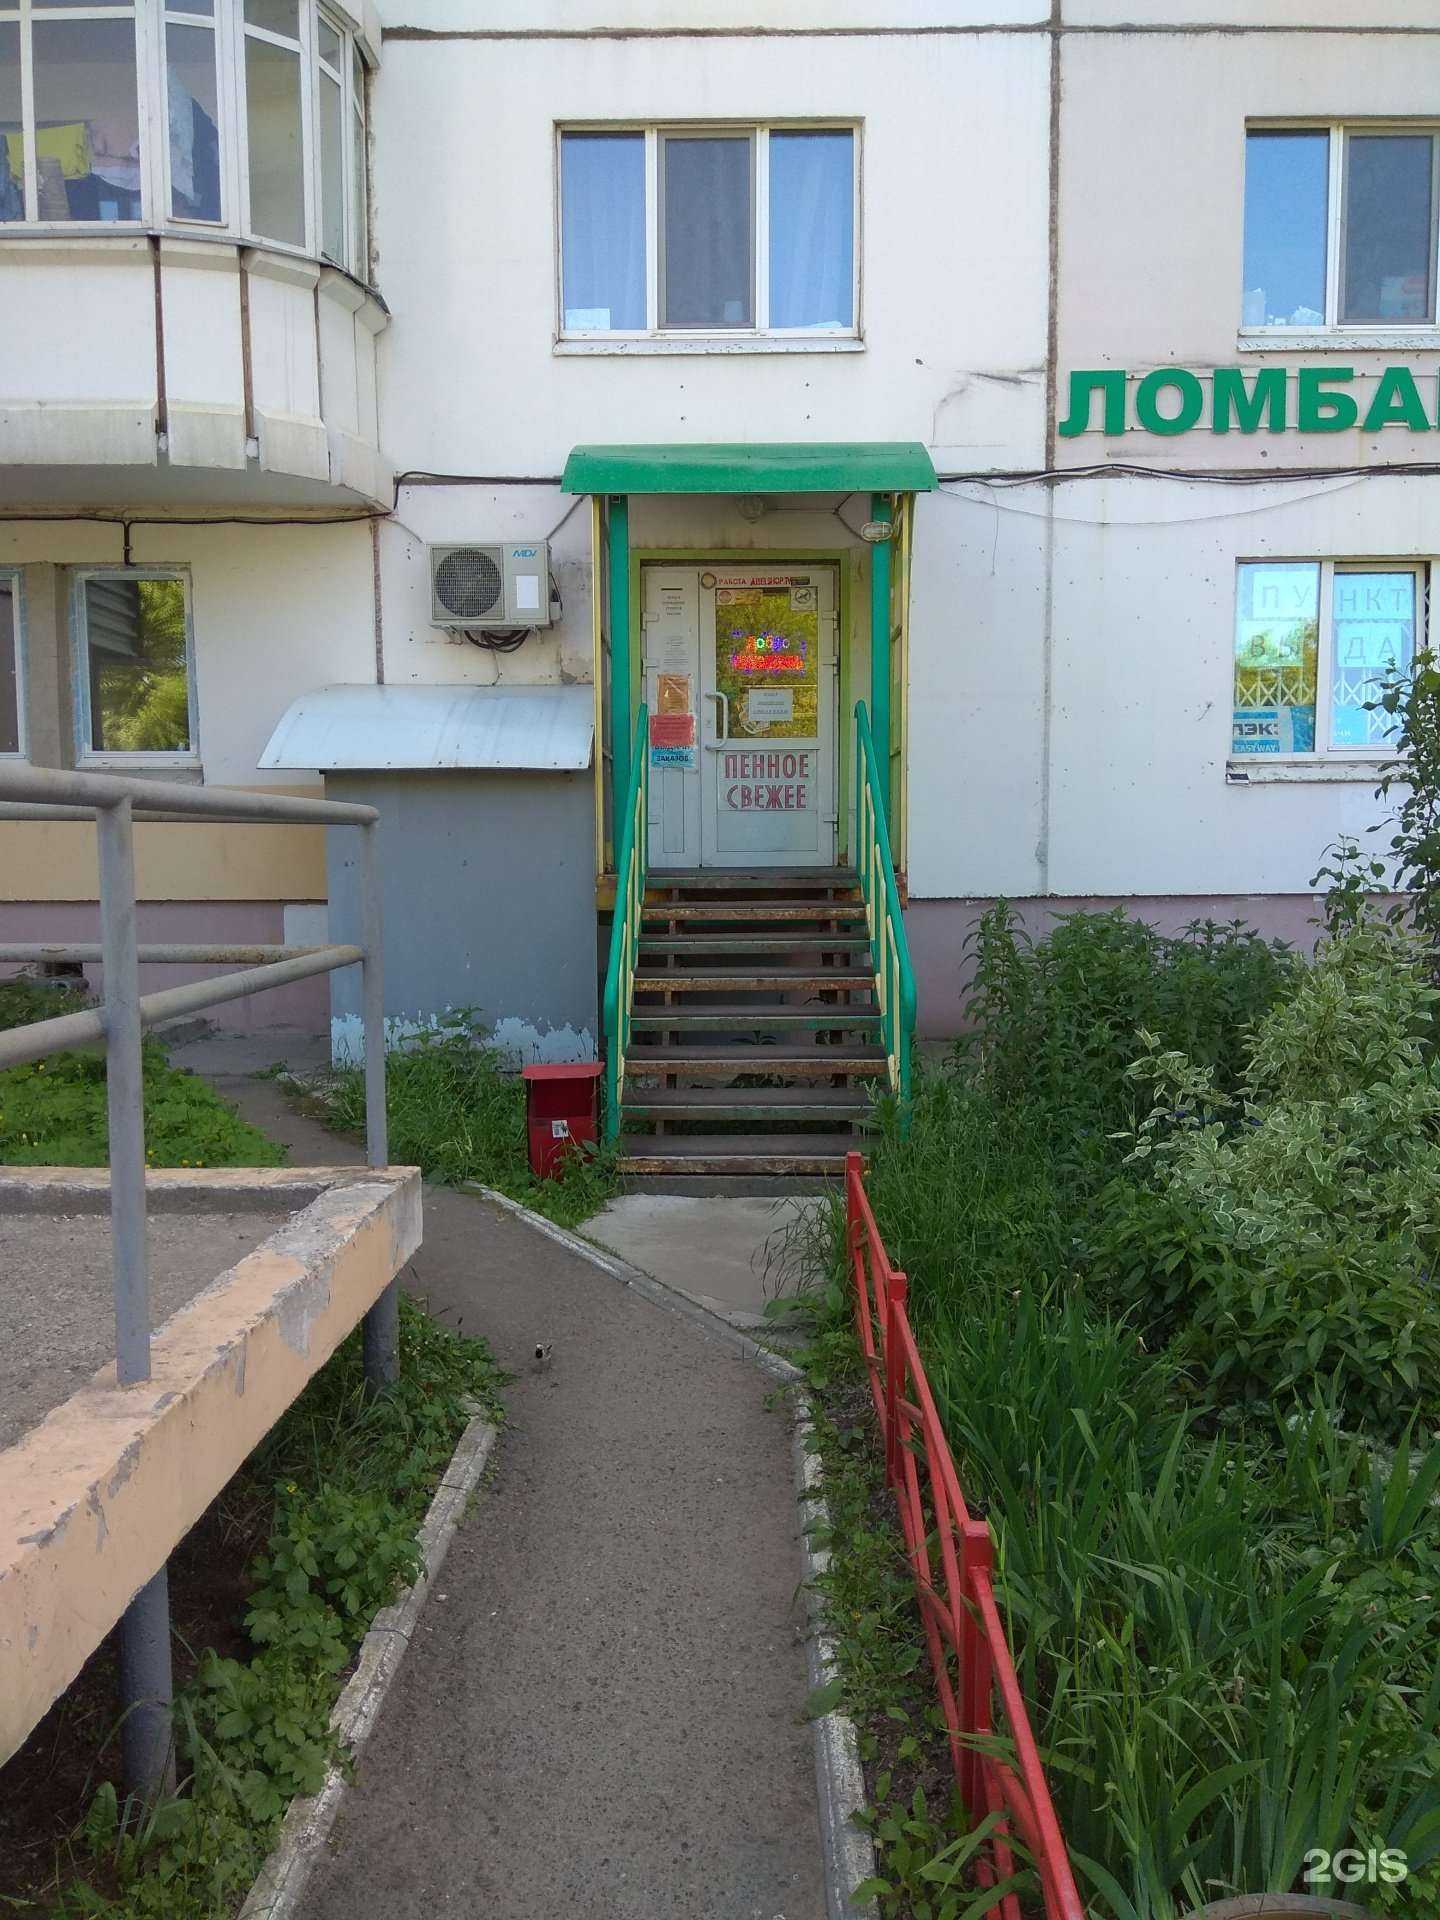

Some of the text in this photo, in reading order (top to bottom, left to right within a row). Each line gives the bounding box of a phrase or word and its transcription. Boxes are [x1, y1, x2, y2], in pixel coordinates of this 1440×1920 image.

[1058, 366, 1440, 437] ЛОМБА
[512, 549, 536, 557] MDV
[725, 753, 809, 779] ПЕННОЕ
[726, 784, 807, 809] СВЕЖЕЕ
